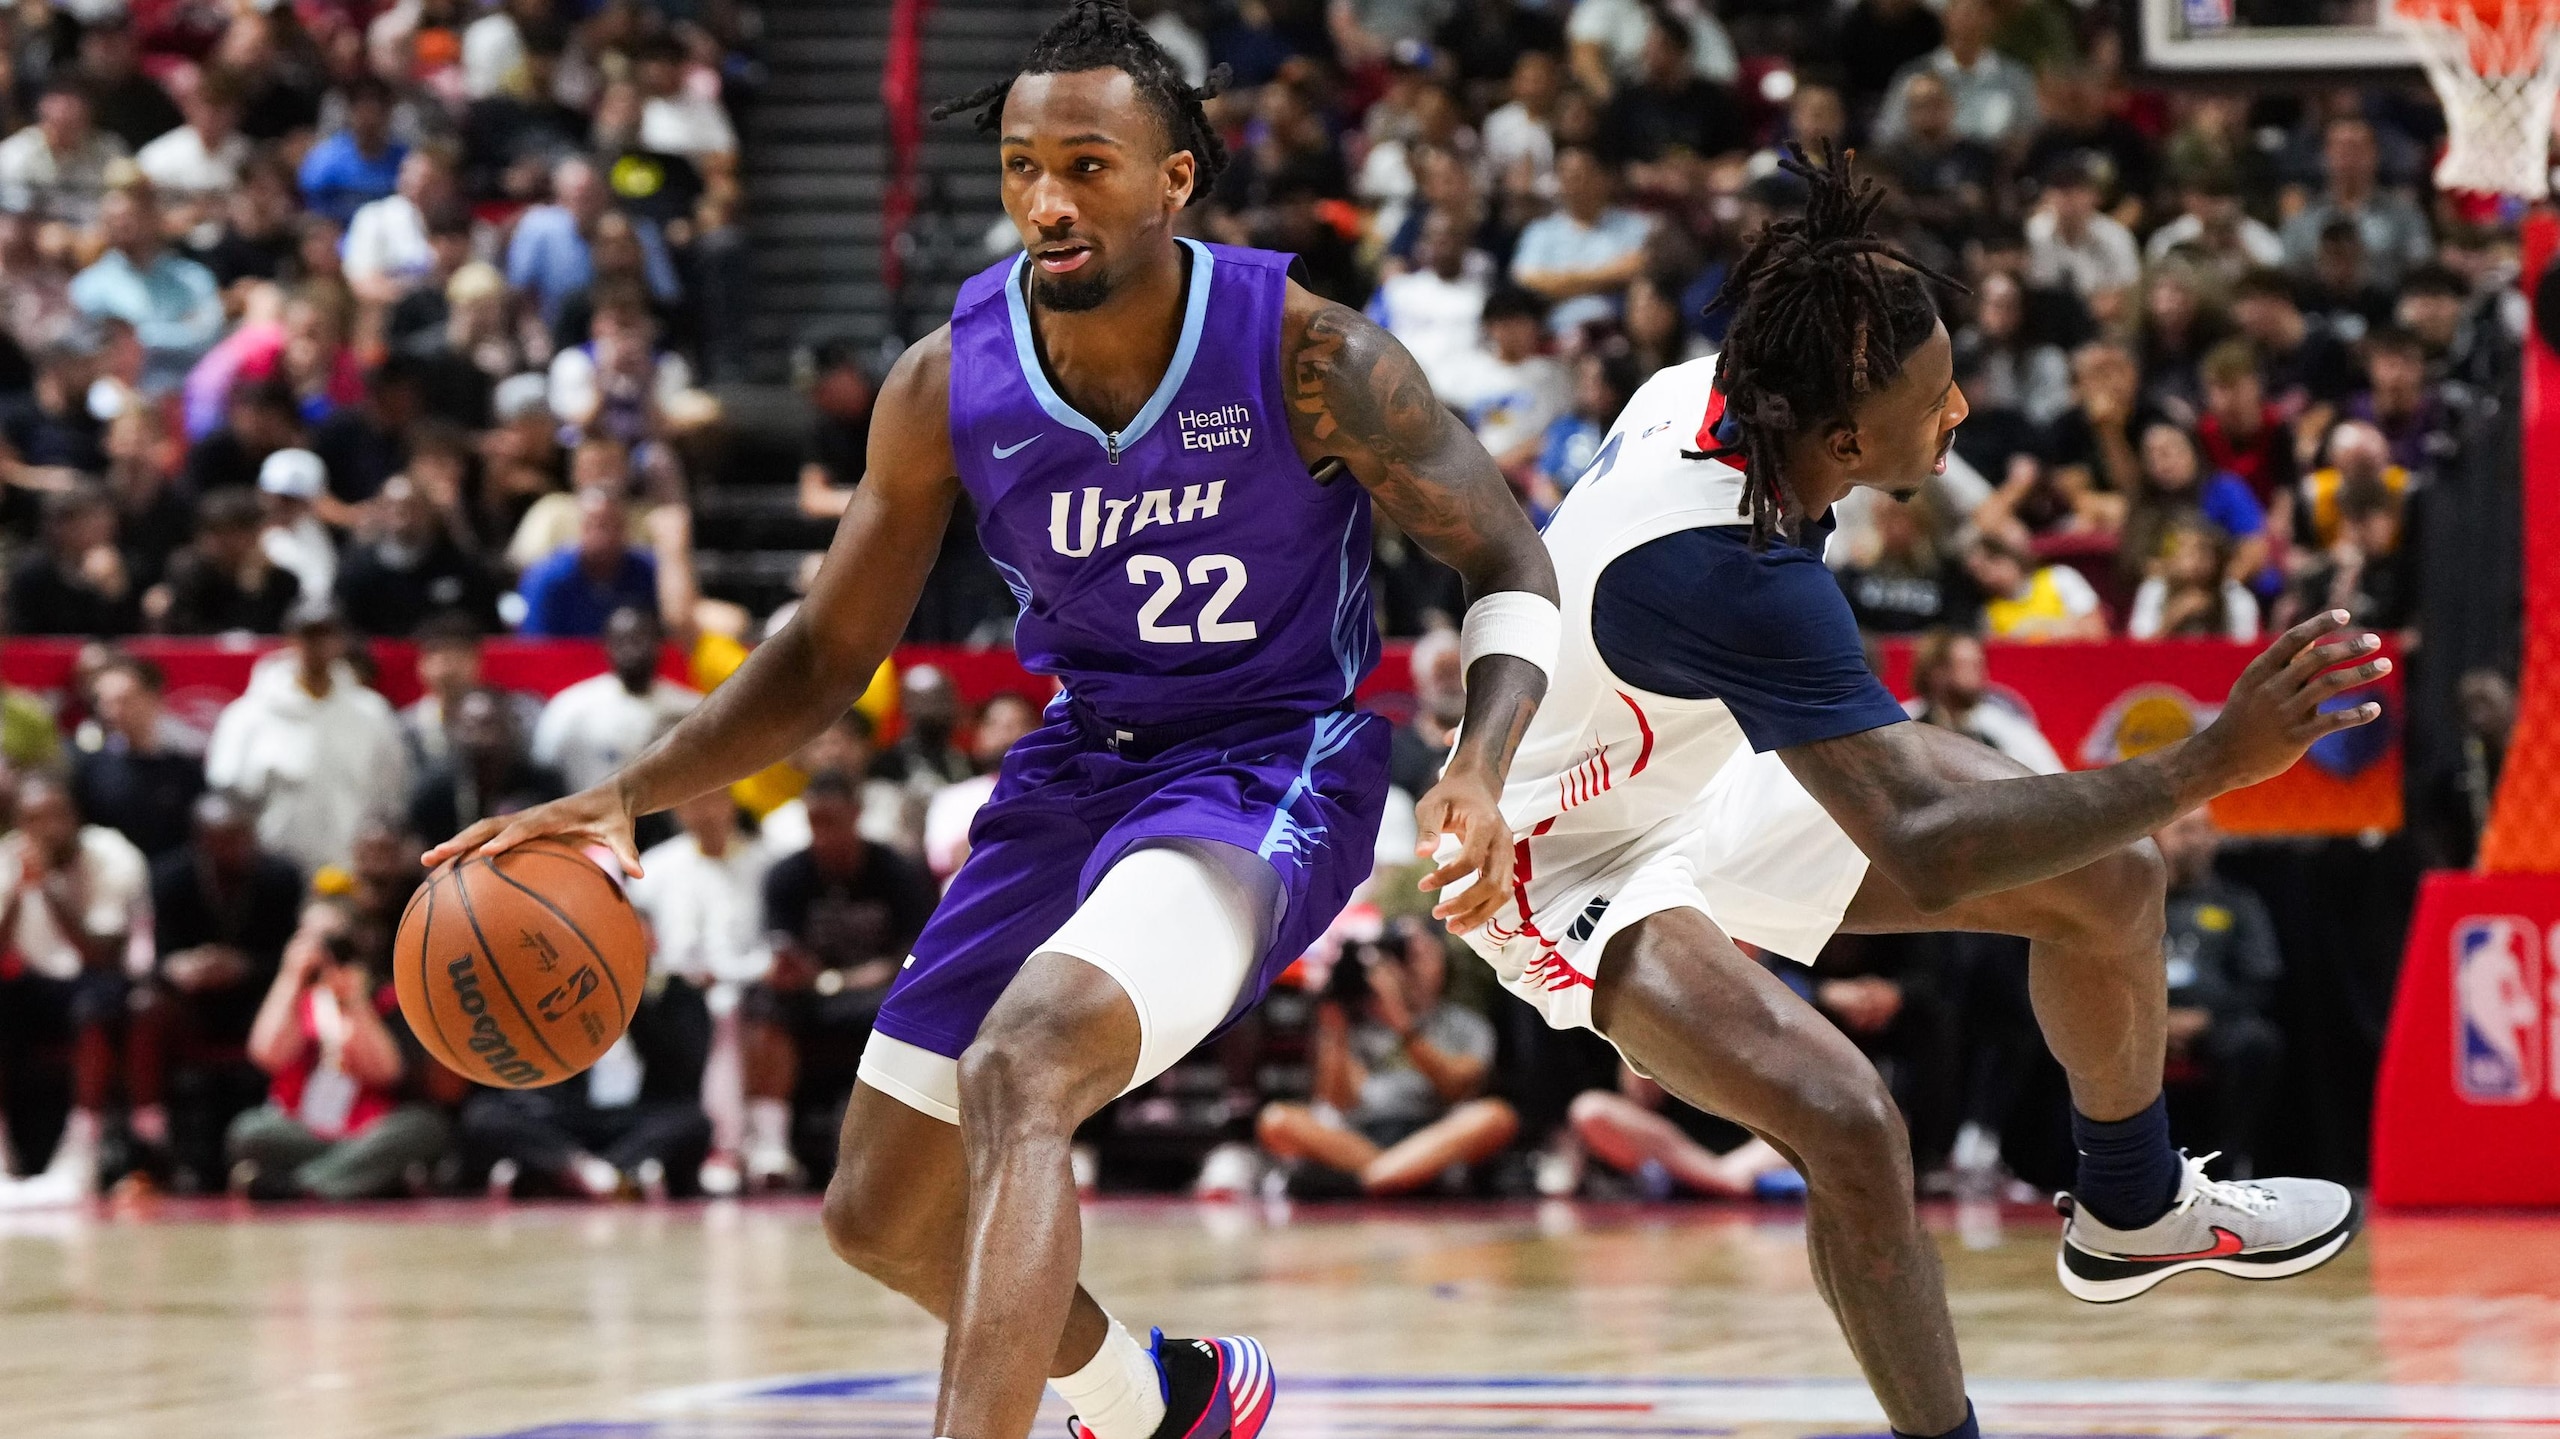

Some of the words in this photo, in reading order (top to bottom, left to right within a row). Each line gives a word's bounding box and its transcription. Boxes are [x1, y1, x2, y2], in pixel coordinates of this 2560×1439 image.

[1178, 404, 1249, 429] Health
[1182, 427, 1252, 452] Equity
[1048, 480, 1226, 557] UTAH
[1126, 554, 1257, 643] 22
